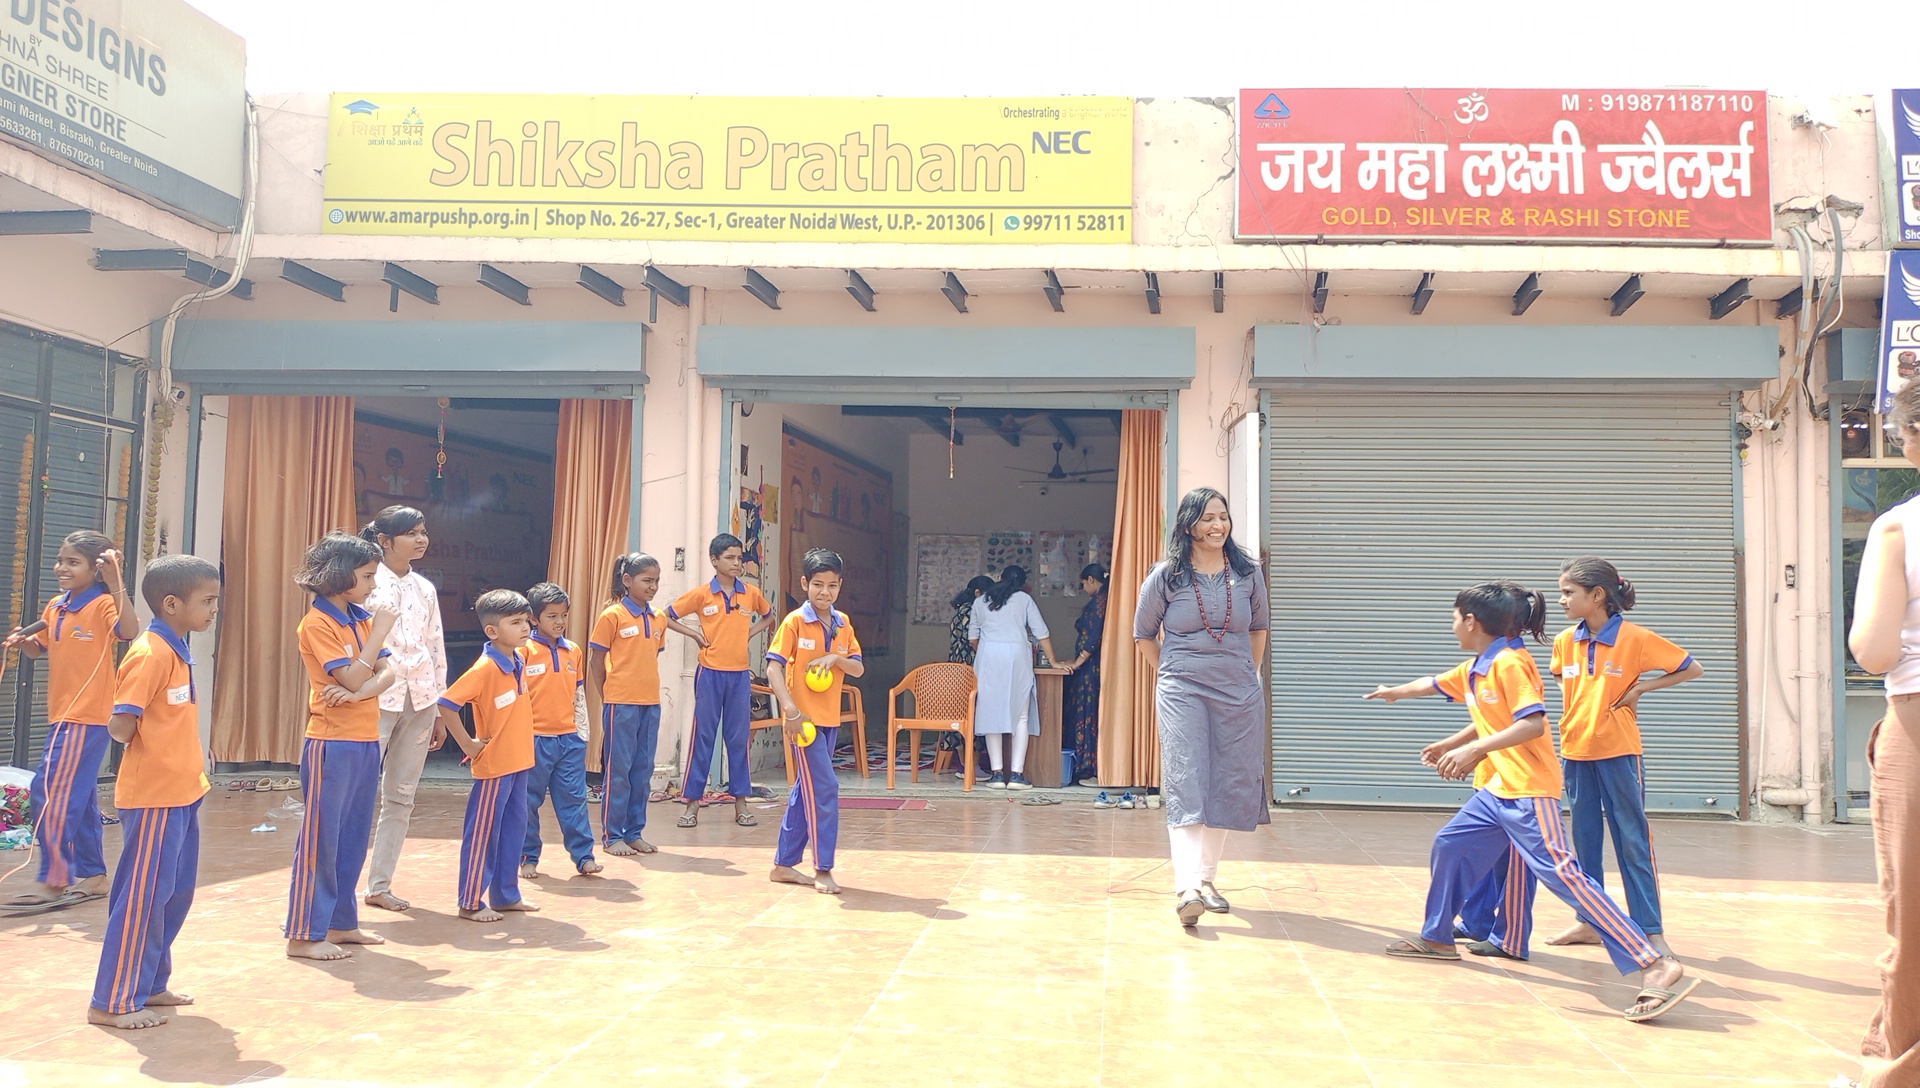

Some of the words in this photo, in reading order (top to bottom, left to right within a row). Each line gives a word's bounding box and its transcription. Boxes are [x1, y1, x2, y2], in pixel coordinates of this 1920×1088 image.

[11, 0, 166, 97] DESIGNS
[30, 34, 42, 47] BY
[45, 55, 108, 101] SHREE
[2, 63, 58, 110] GNER
[65, 93, 127, 143] STORE
[1003, 106, 1060, 120] Orchestrating
[1562, 94, 1580, 112] M
[1601, 93, 1754, 112] 919871187110
[19, 104, 57, 133] Market,
[60, 122, 97, 151] Bisrakh,
[100, 141, 132, 165] Greater
[134, 157, 158, 177] Noida
[351, 119, 387, 138] शिक्षा
[391, 124, 425, 137] प्रथम
[49, 138, 105, 171] 8765702341
[1032, 130, 1092, 155] NEC
[429, 119, 704, 190] Shiksha
[725, 123, 1026, 192] Pratham
[1256, 142, 1346, 194] जय
[1355, 142, 1449, 201] महा
[1459, 118, 1587, 199] लक्ष्मी
[1597, 118, 1755, 201] ज्वैलर्स
[344, 207, 530, 229] www.amarpushp.org.in
[546, 208, 587, 230] Shop
[590, 209, 616, 227] No.
[620, 210, 670, 230] 26-27,
[674, 211, 722, 231] Sec-1,
[726, 211, 786, 230] Greater
[790, 212, 837, 231] Noida
[840, 213, 883, 232] West,
[926, 213, 986, 231] 201306
[1023, 214, 1071, 231] 99711
[1077, 214, 1125, 231] 52811
[1321, 207, 1398, 229] GOLD,
[1405, 207, 1491, 226] SILVER
[1500, 208, 1516, 227] &
[1524, 208, 1599, 227] RASHI
[1607, 208, 1690, 228] STONE
[512, 472, 538, 487] NEC
